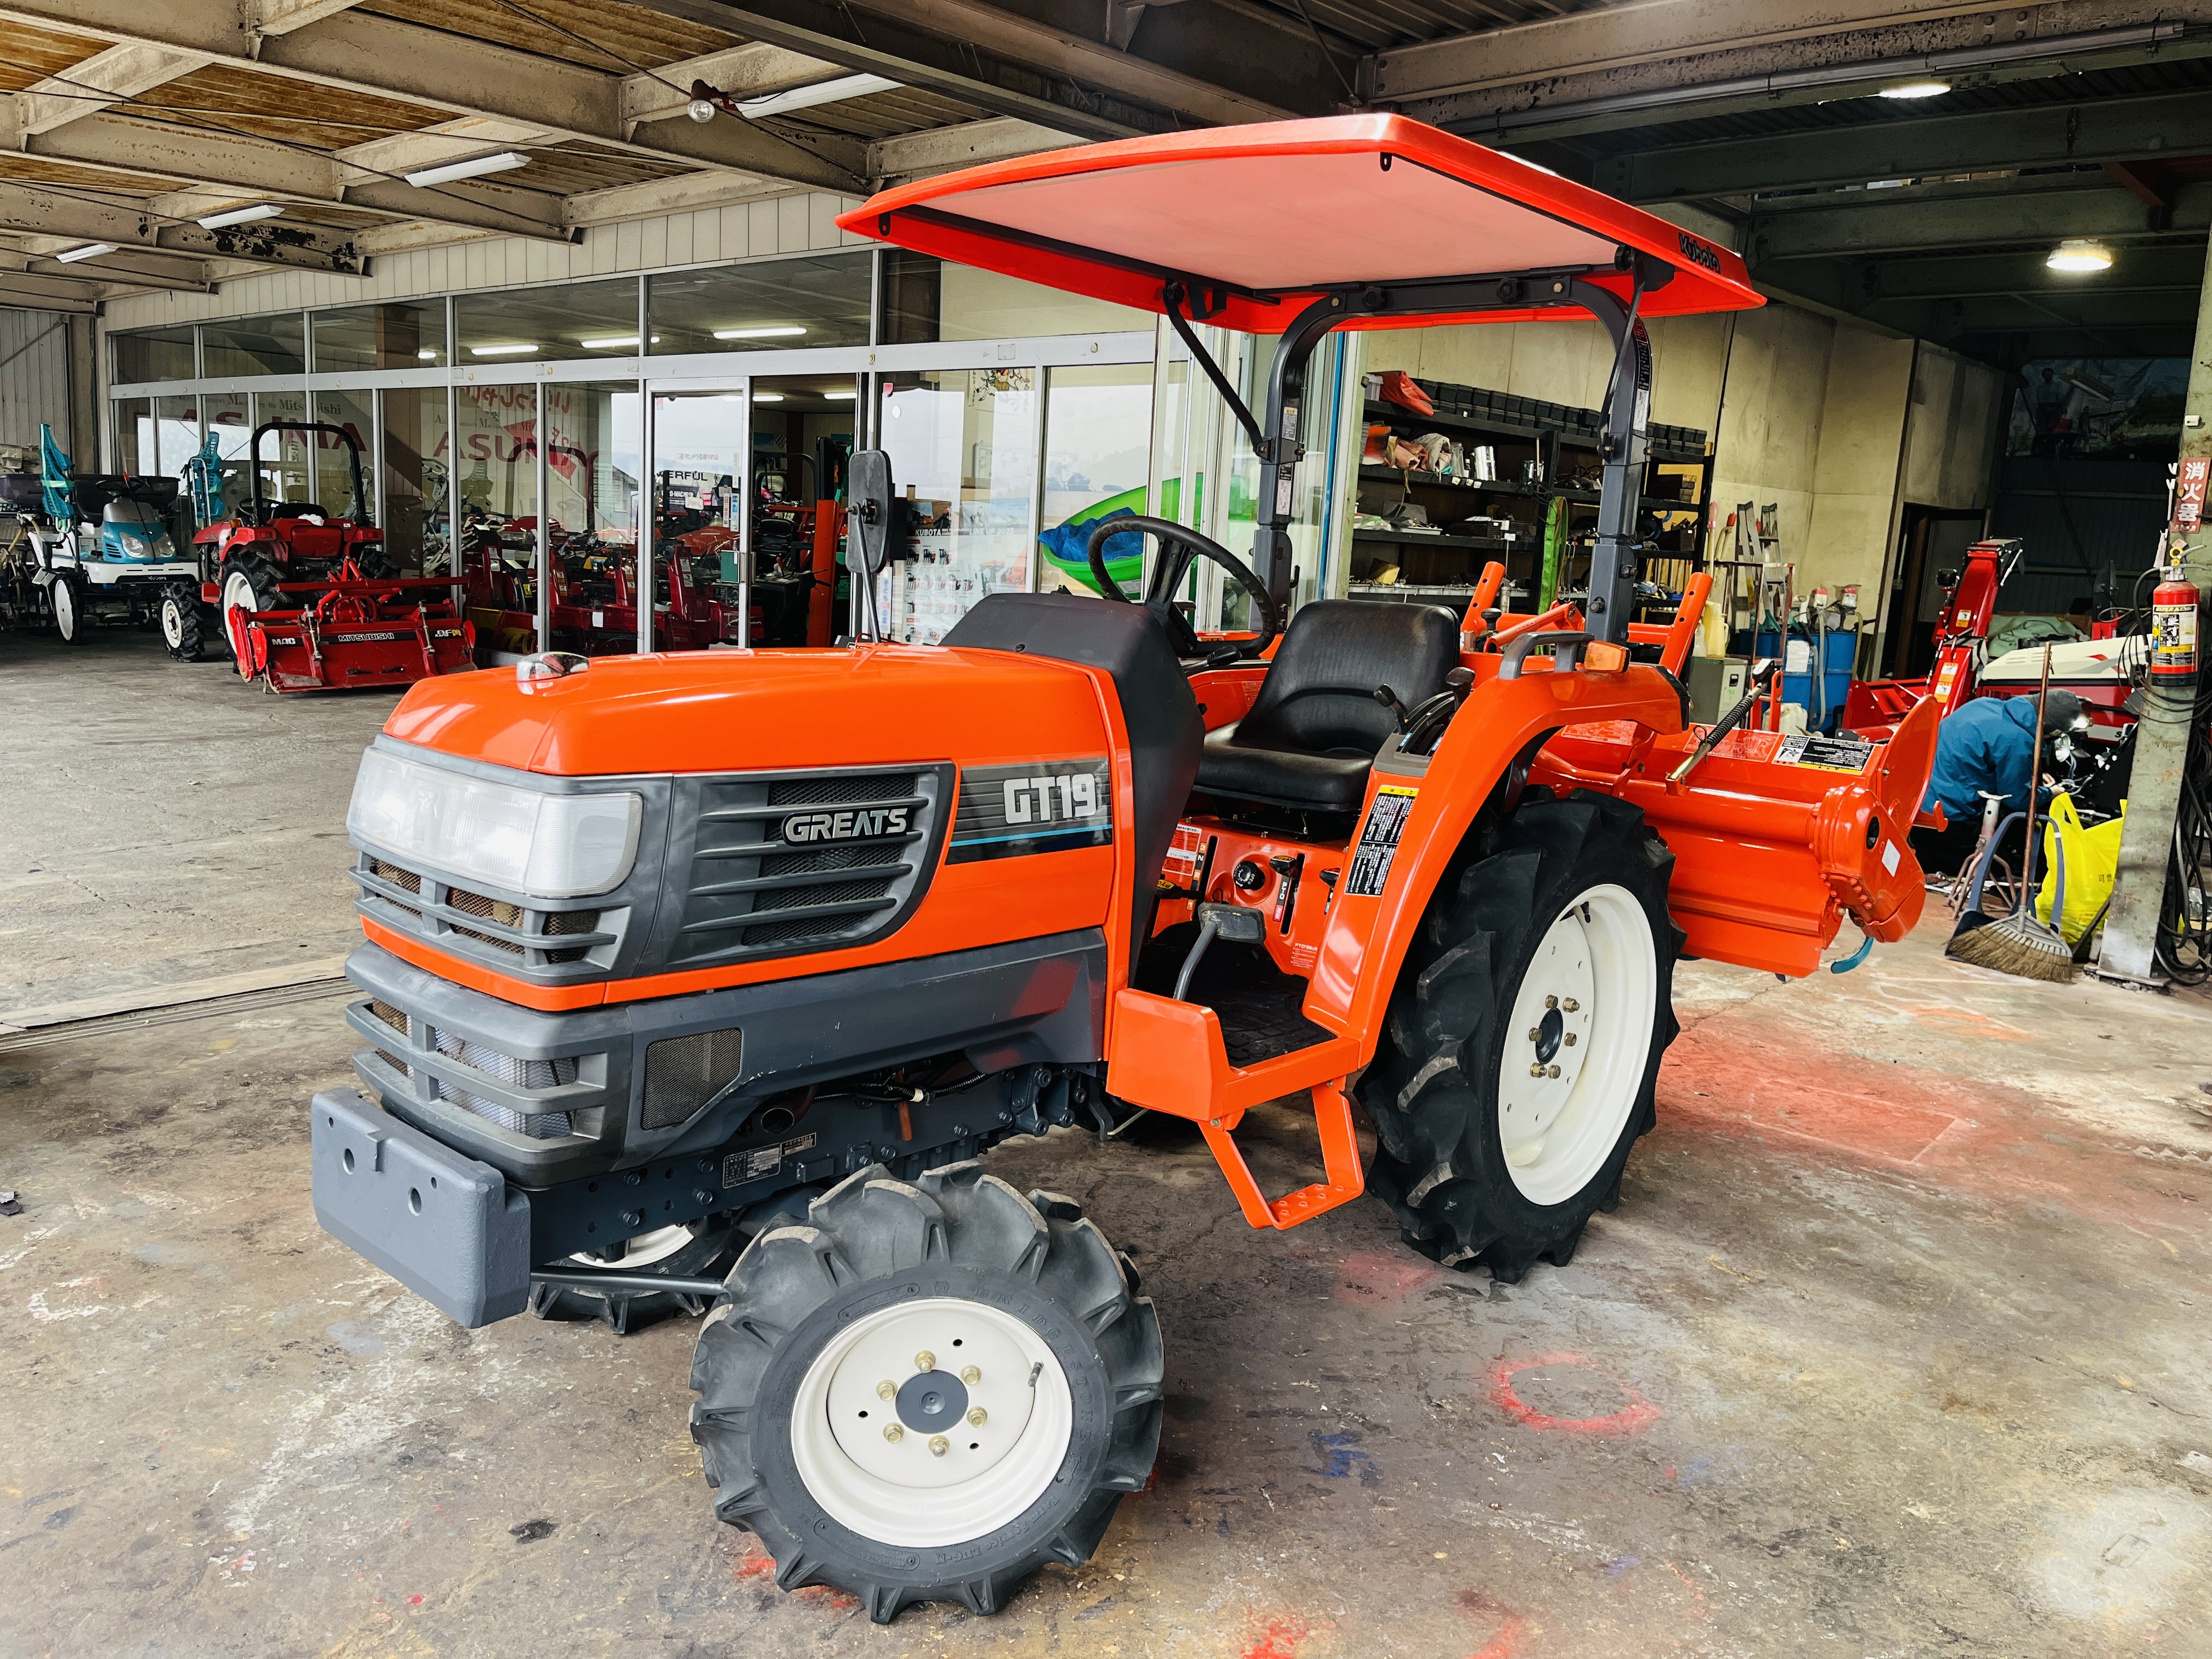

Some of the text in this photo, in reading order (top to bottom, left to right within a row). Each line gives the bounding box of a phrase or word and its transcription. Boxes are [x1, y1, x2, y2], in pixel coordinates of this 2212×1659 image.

[1678, 232, 1720, 274] Kubota
[2177, 461, 2205, 521] 消火器
[338, 633, 394, 642] MITSUBISHI
[1003, 773, 1097, 824] GT19
[785, 808, 907, 842] GREATS
[1279, 882, 1288, 900] PTO
[973, 1288, 1093, 1442] BRIDGESTONE
